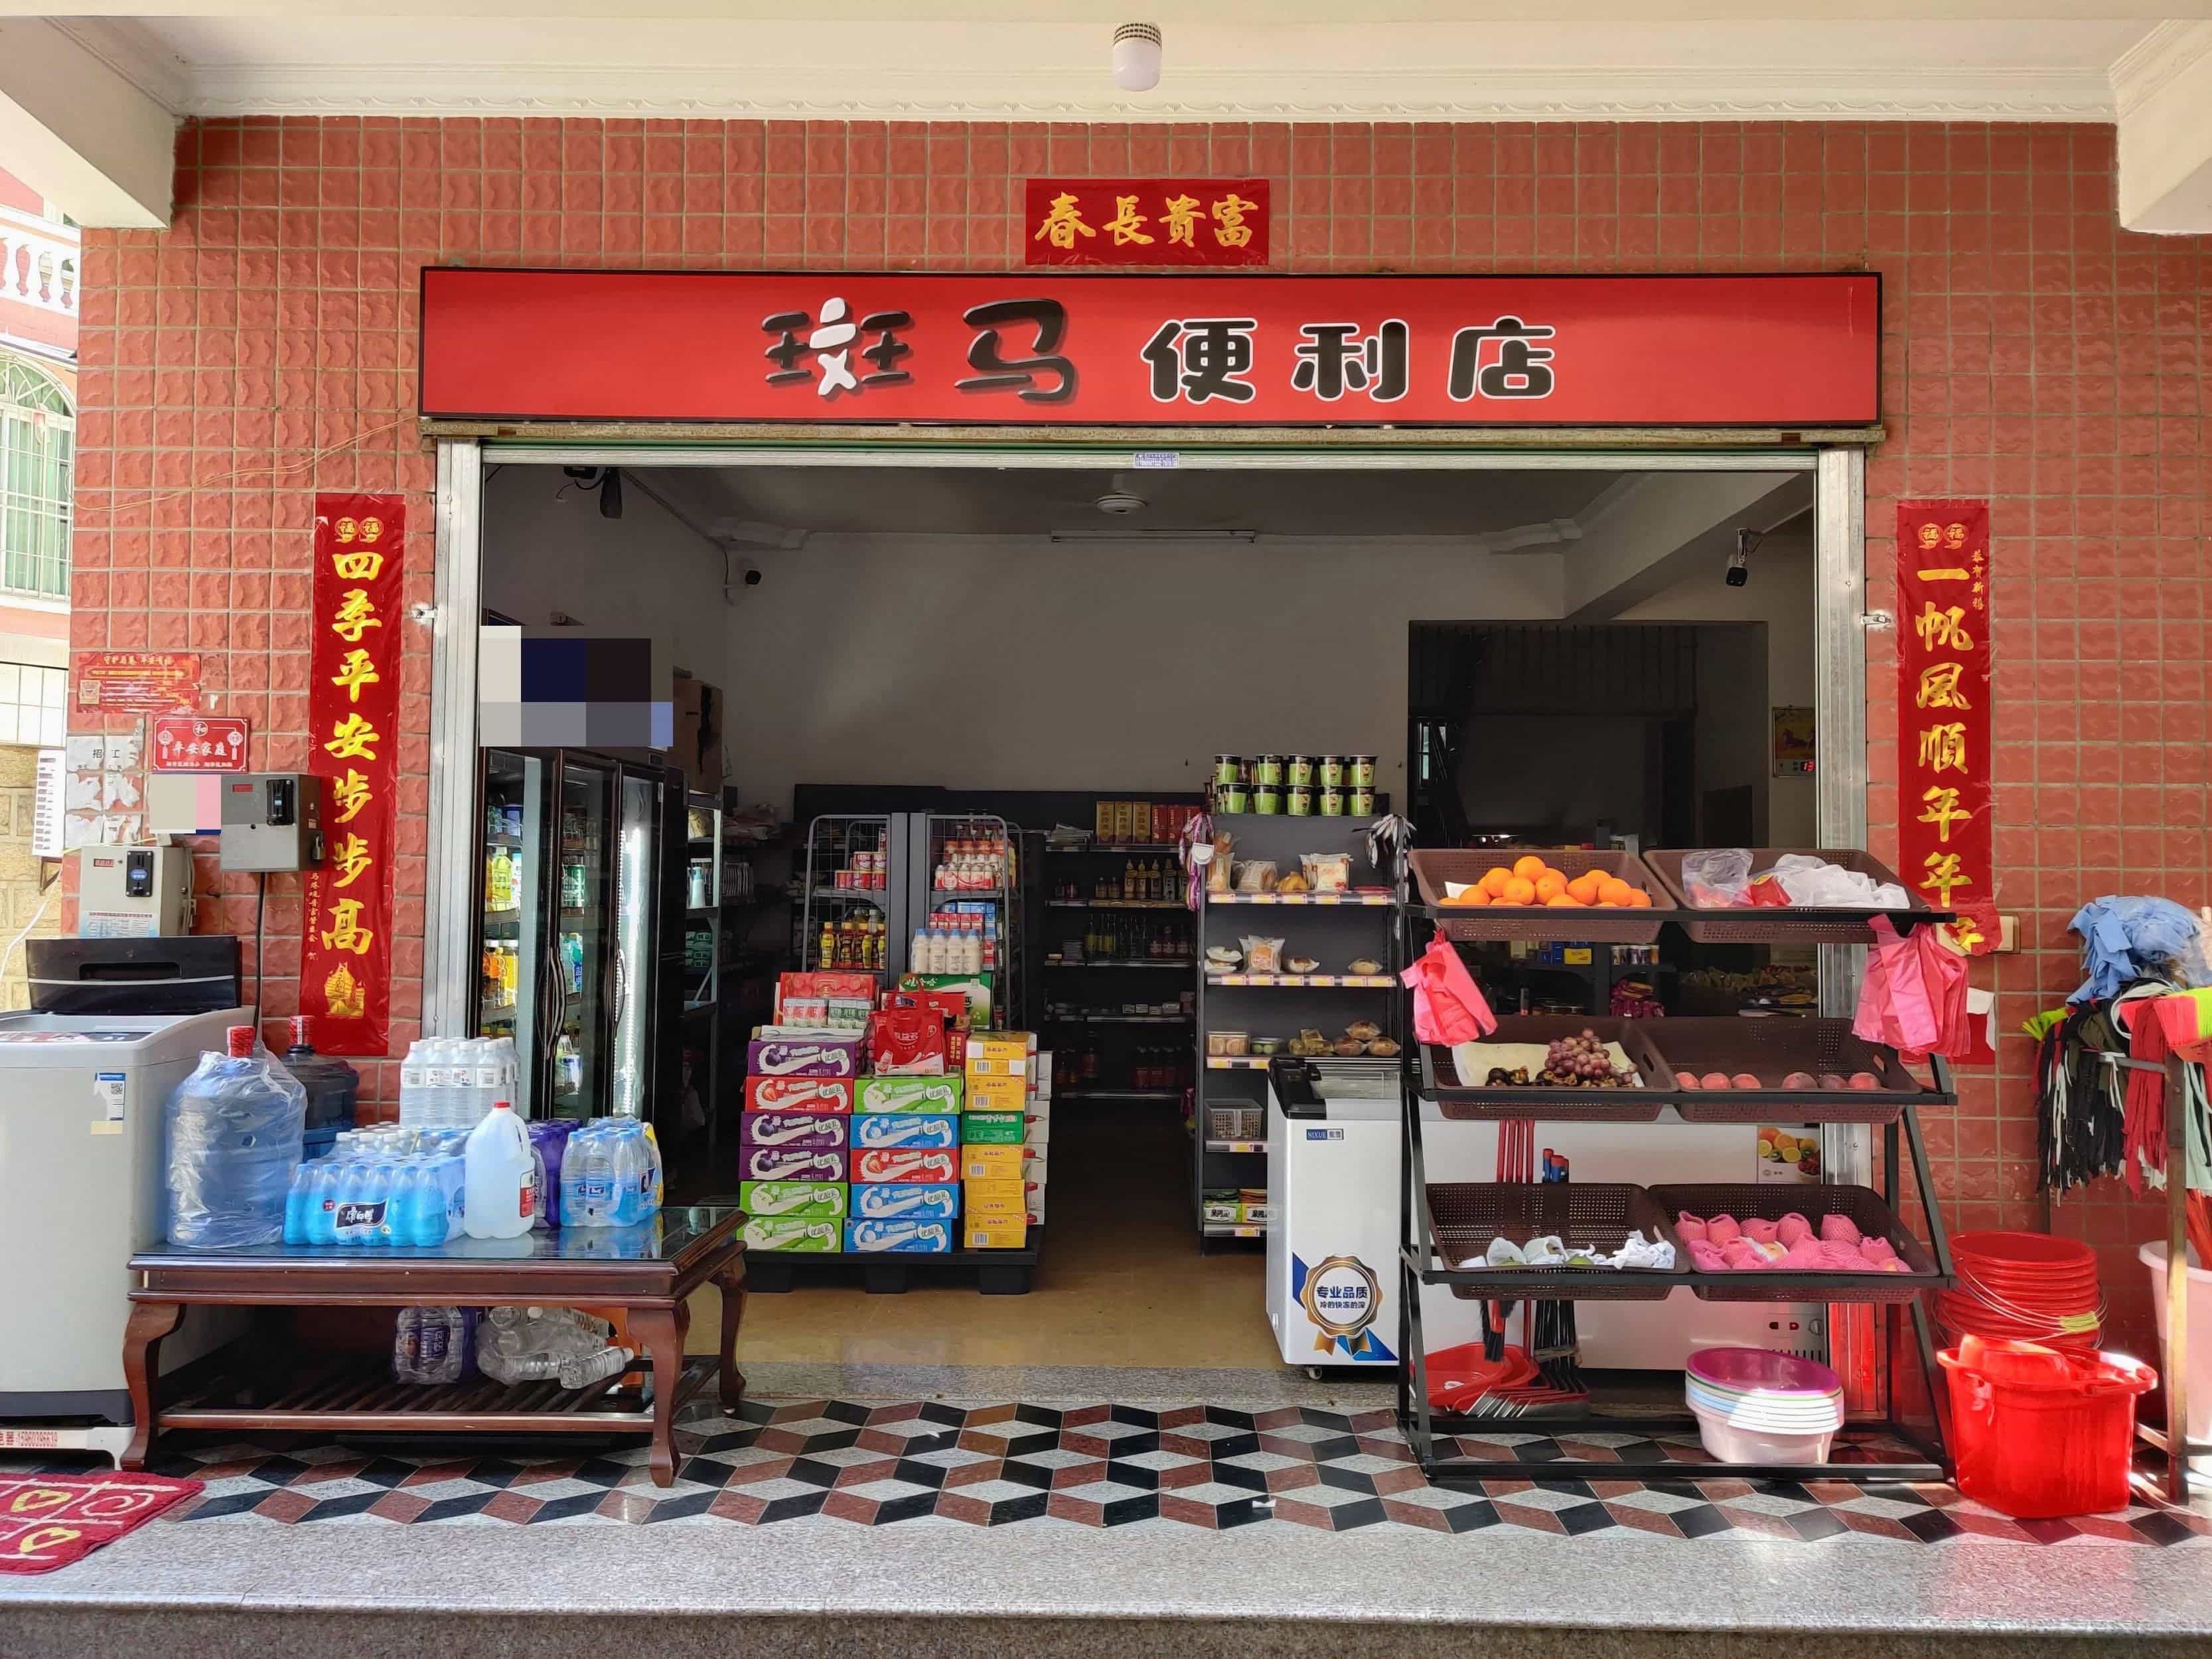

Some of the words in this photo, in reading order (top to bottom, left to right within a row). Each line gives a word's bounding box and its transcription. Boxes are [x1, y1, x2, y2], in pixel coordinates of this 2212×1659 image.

[761, 297, 1556, 405] 斑马便利店
[173, 740, 228, 757] 平安家庭
[1316, 1285, 1368, 1299] 专业品质
